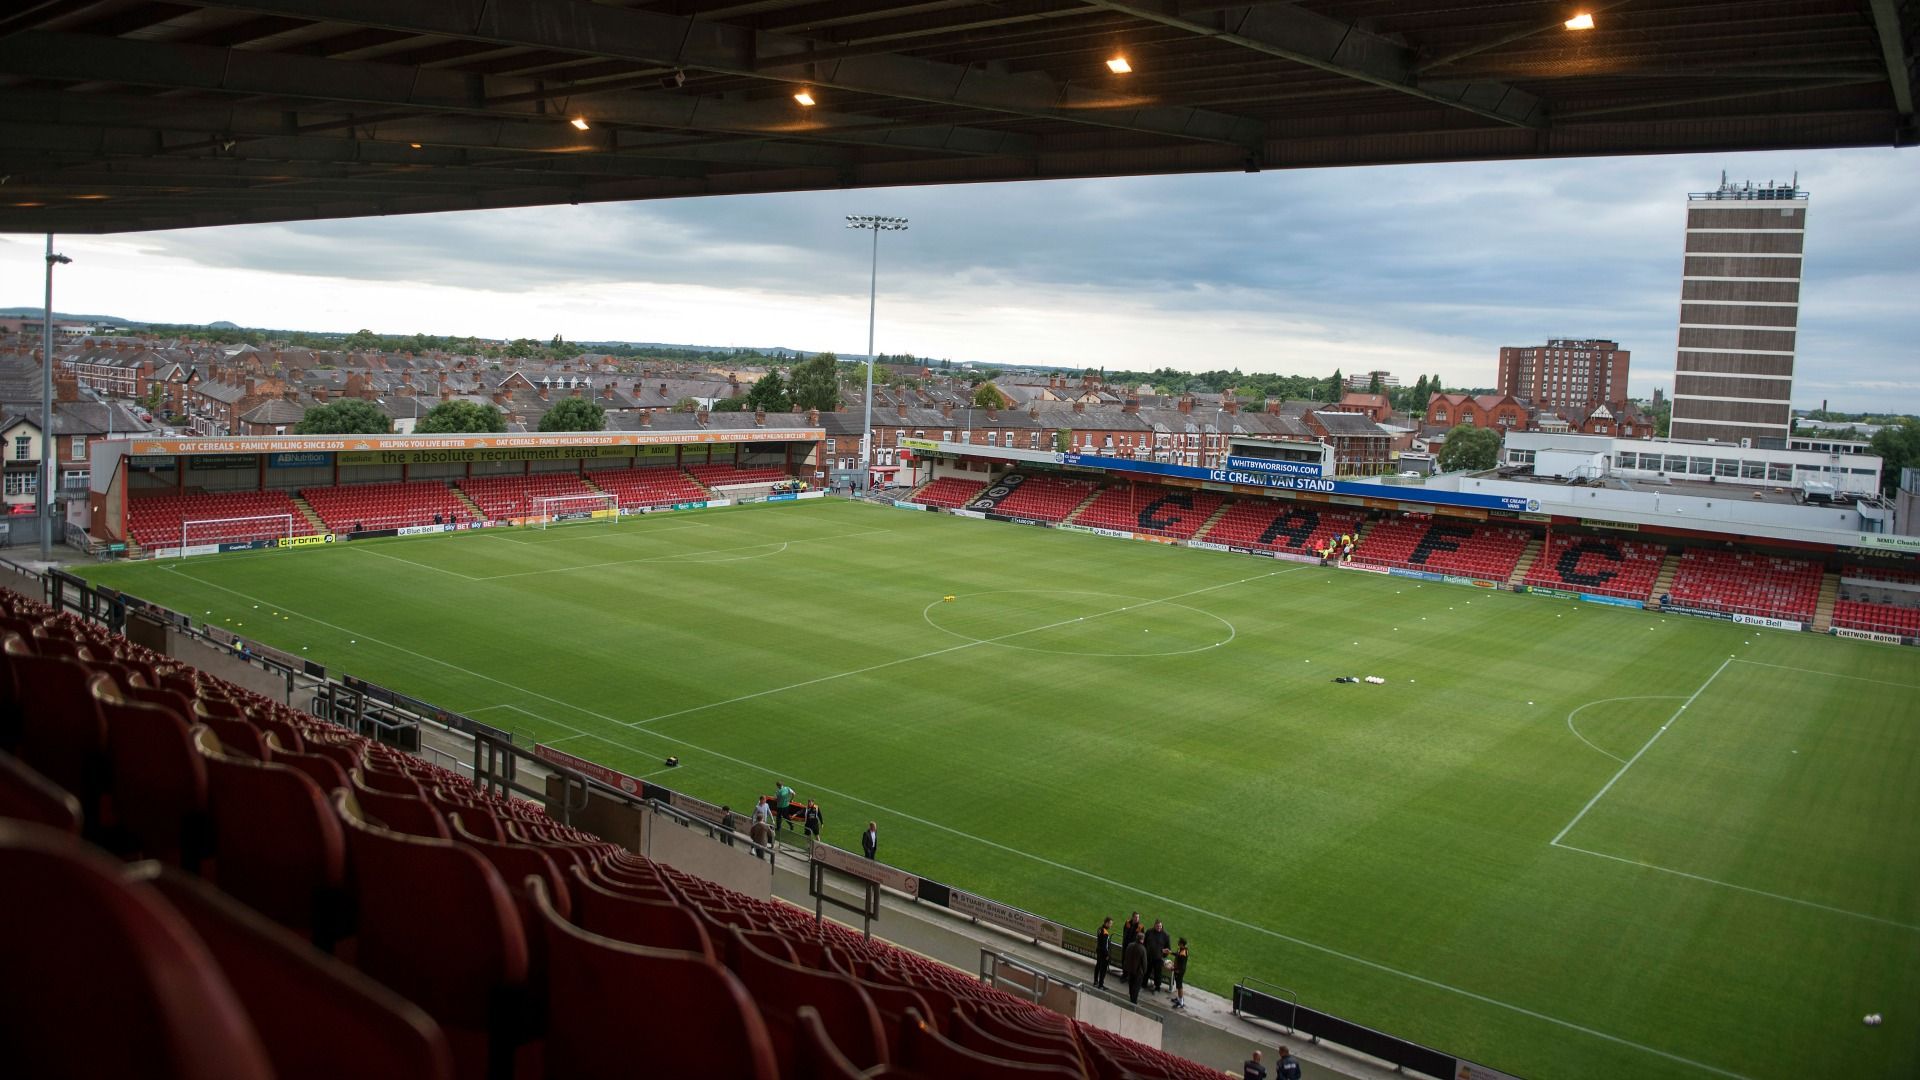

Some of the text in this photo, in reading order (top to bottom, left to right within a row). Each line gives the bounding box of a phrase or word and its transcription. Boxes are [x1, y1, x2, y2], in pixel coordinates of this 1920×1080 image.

[179, 443, 197, 451] OAT
[198, 442, 234, 451] CEREALS
[241, 441, 269, 451] FAMILY
[270, 441, 303, 450] MILLING
[303, 441, 326, 449] SINCE
[327, 441, 345, 449] 1675
[380, 440, 409, 448] HELPING
[441, 439, 465, 447] BETTER
[382, 446, 598, 463] the absolute recruitment stand
[1231, 459, 1319, 475] WHITBYMORRISON.COM
[1210, 469, 1335, 491] ICE CREAM VAN STAND
[471, 521, 482, 529] sky
[1744, 616, 1764, 625] Blue
[1765, 619, 1782, 627] Bell
[1838, 629, 1900, 643] CHETWODE MOTORS
[960, 894, 985, 907] STUART
[986, 903, 1007, 915] SHAW
